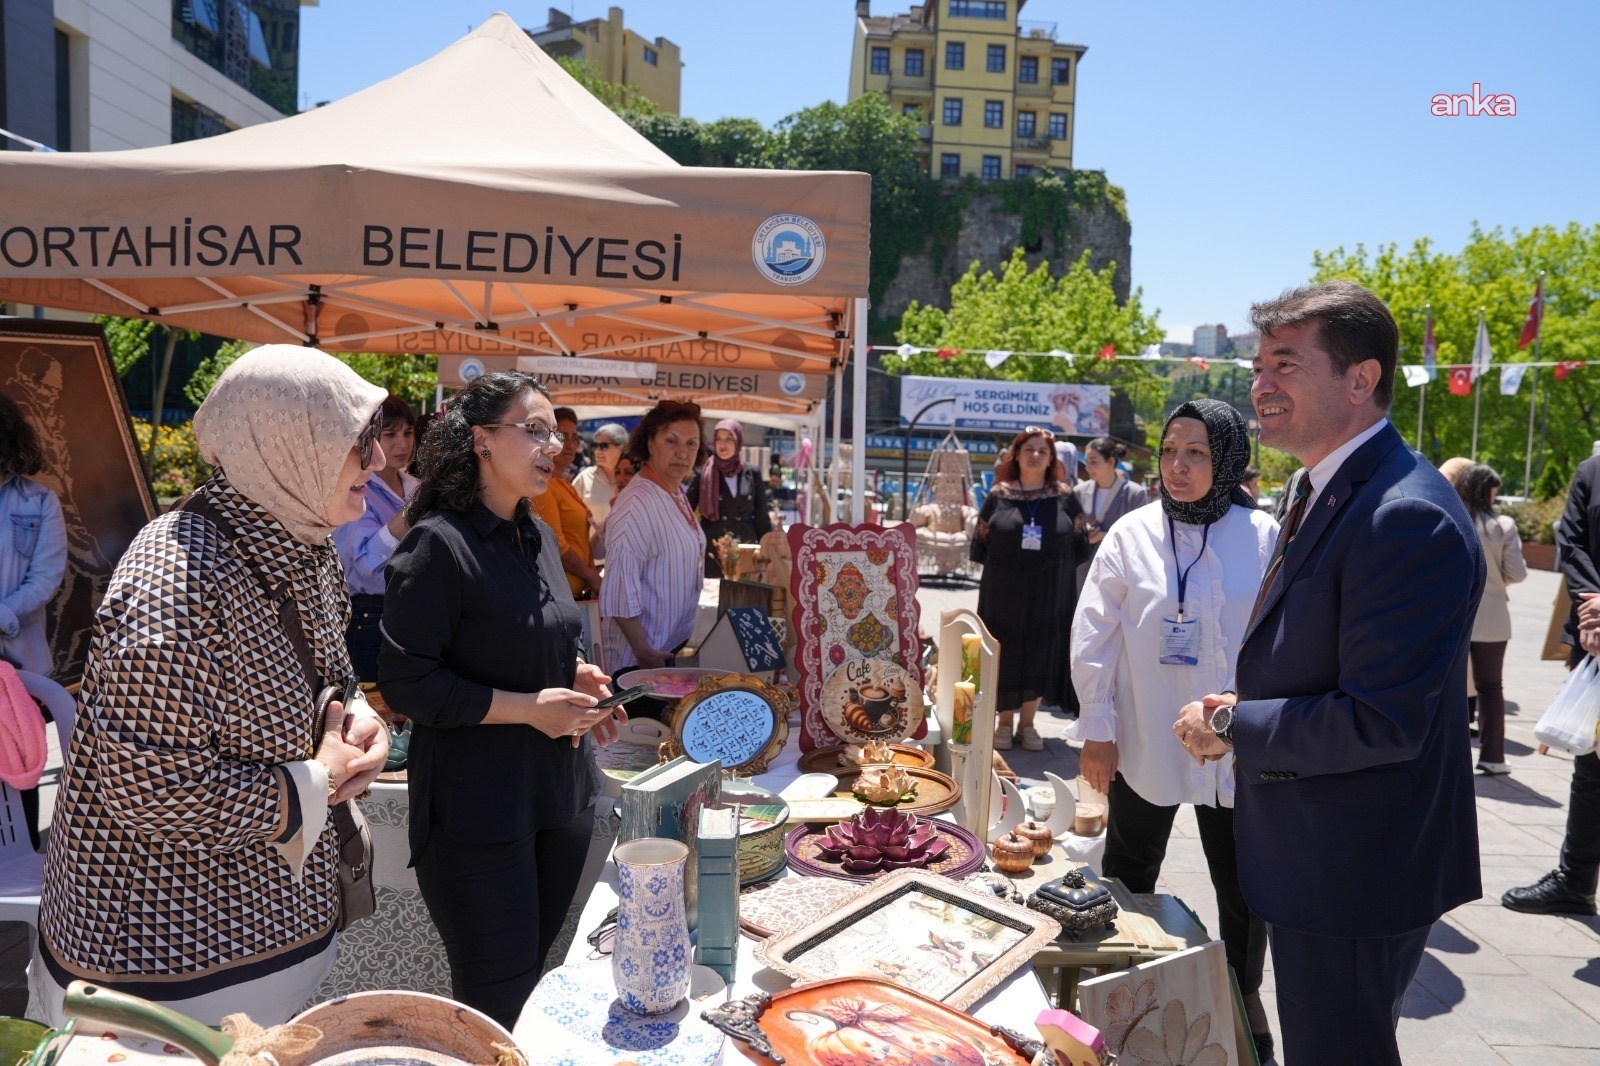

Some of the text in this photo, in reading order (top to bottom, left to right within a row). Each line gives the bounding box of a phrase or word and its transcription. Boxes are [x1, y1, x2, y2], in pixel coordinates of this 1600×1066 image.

[756, 217, 823, 247] ORTAHİSAR BELEDİYESİ
[1, 217, 682, 282] ORTAHİSAR BELEDİYESİ
[772, 273, 802, 282] TRABZON
[975, 389, 1039, 402] SERGİMİZE
[963, 401, 1050, 416] HOŞ GELDİNİZ
[846, 659, 872, 682] Cafe
